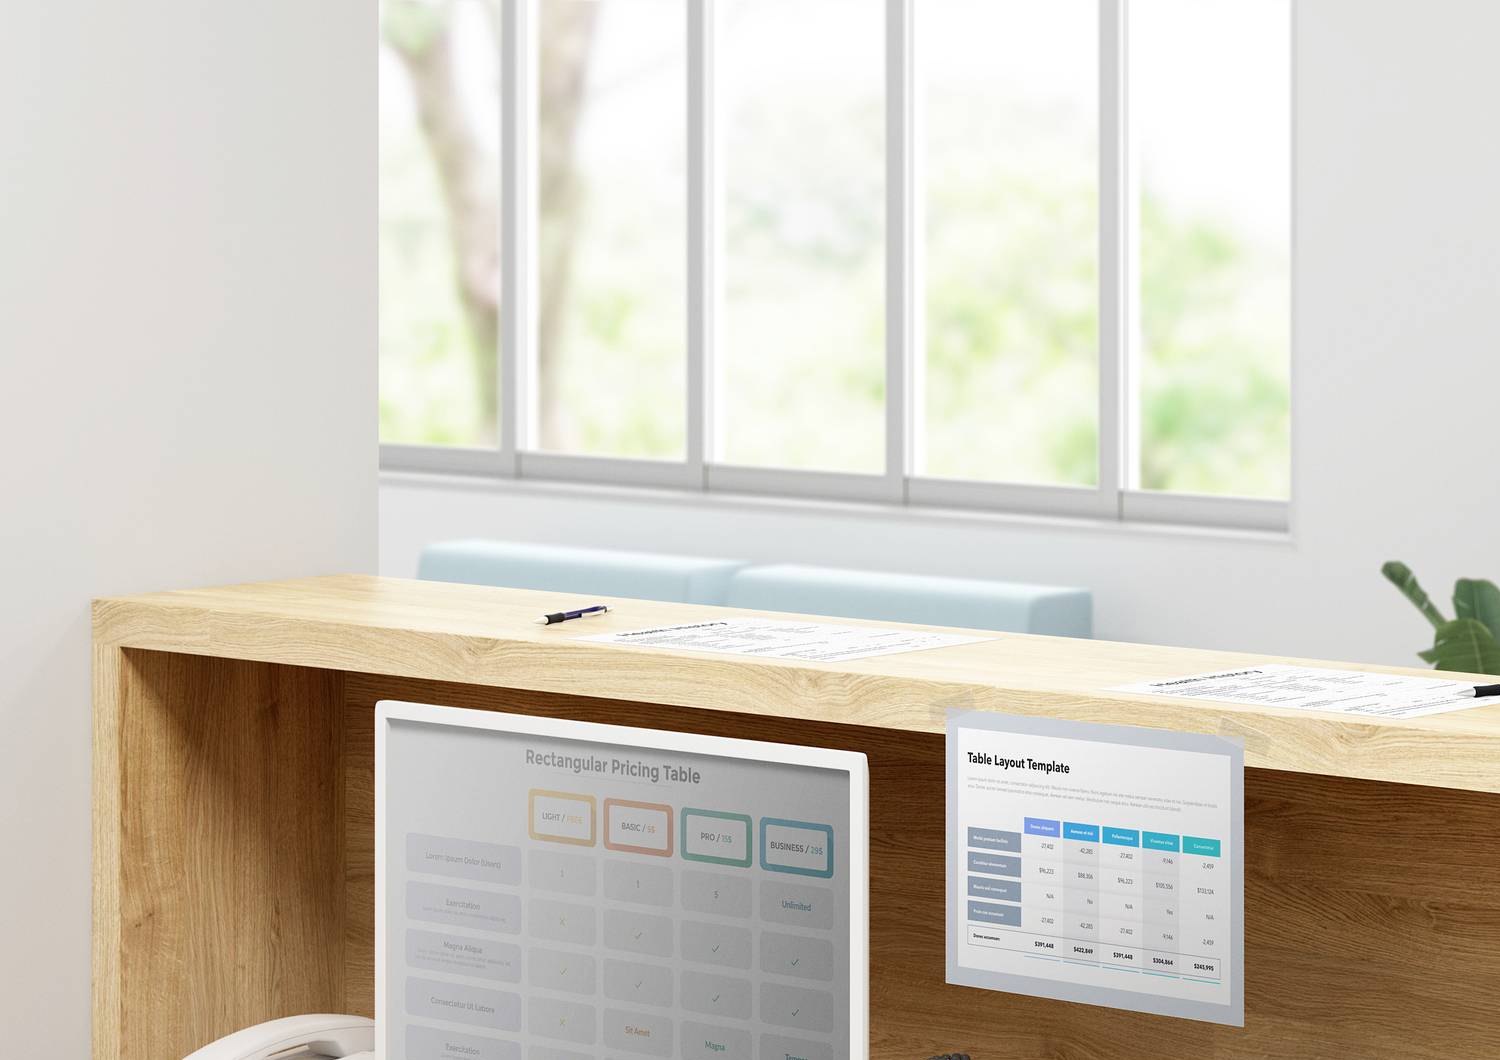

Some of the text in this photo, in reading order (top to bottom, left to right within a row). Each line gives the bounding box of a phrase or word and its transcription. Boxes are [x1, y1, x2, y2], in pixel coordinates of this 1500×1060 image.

[526, 748, 701, 784] Rectangular Pricing Table
[967, 751, 1071, 775] Table Layout Template
[541, 811, 561, 822] LIGHT
[620, 821, 641, 833] BASIC
[700, 831, 716, 842] PRO
[770, 841, 805, 854] BUSINESS
[781, 898, 812, 913] Unlimited
